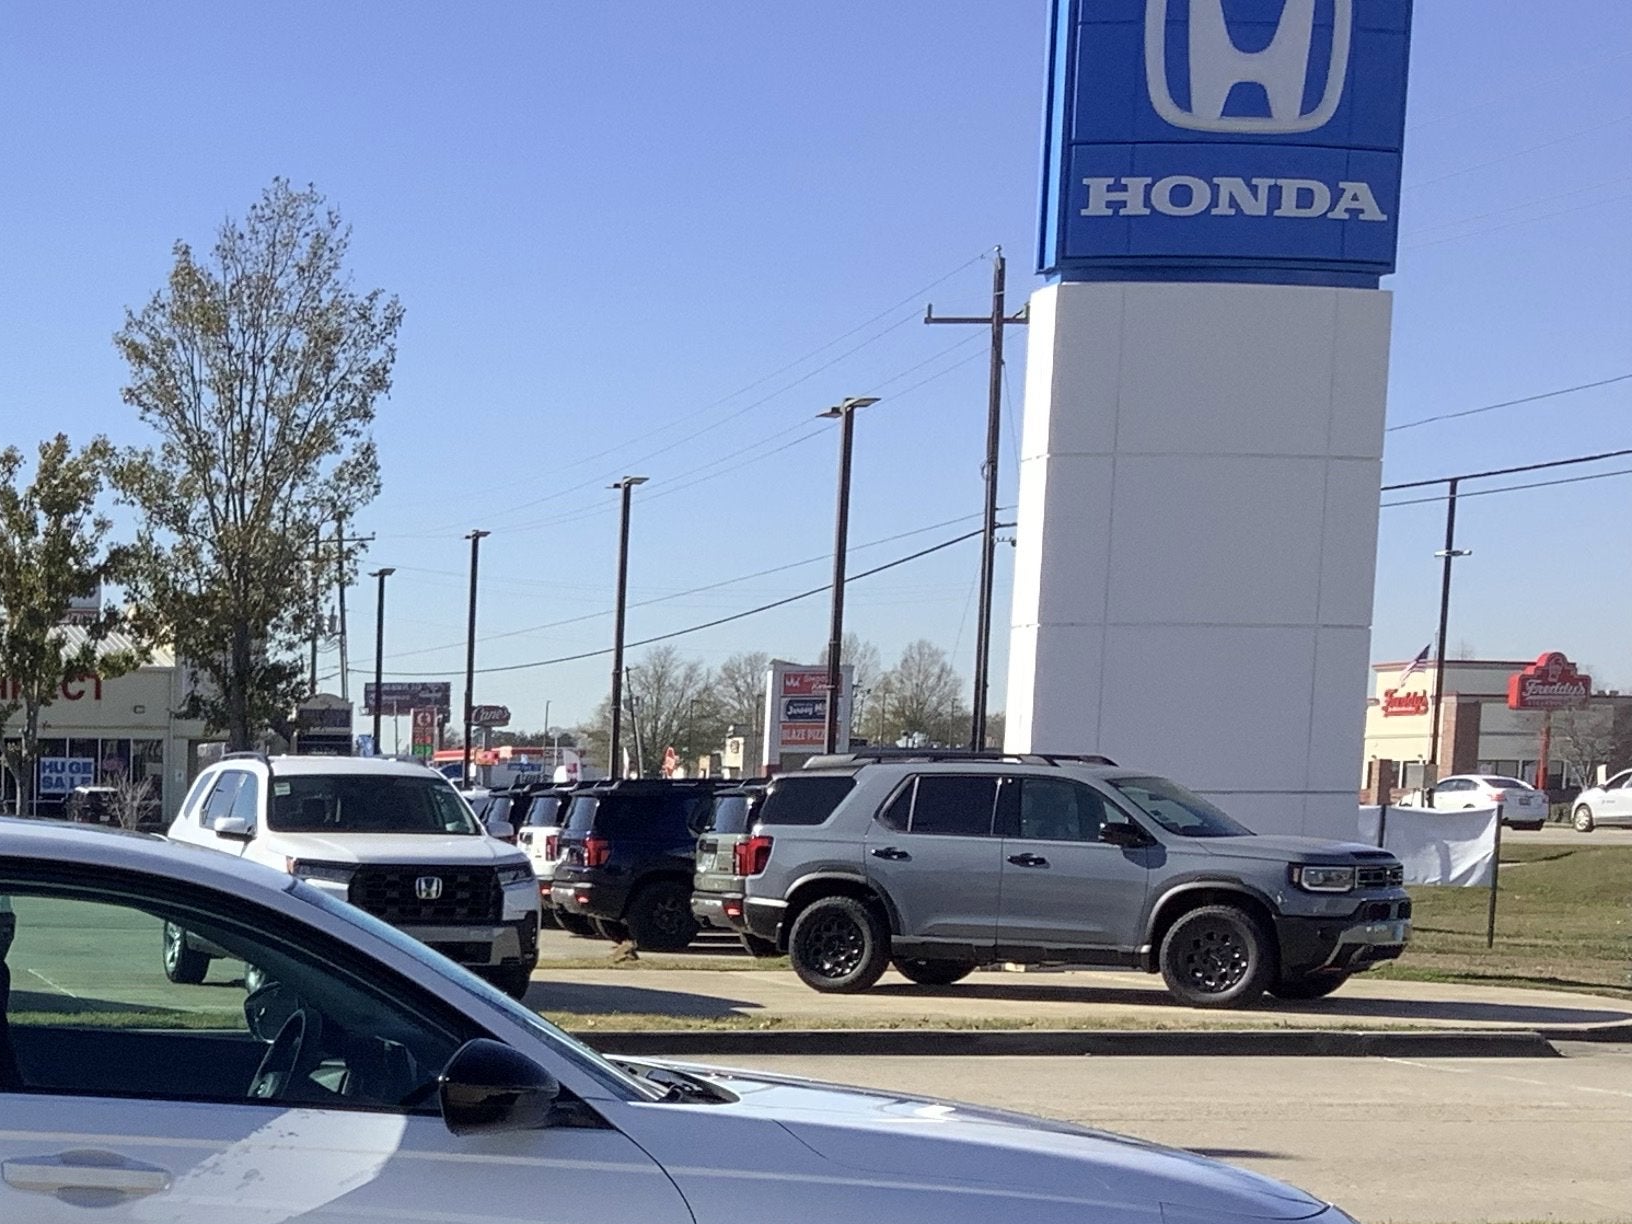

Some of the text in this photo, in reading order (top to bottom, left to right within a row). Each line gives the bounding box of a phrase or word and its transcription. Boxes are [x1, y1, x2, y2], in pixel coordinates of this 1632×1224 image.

[1080, 175, 1388, 221] HONDA
[1522, 679, 1586, 698] Freddy's
[41, 761, 93, 774] HUGE
